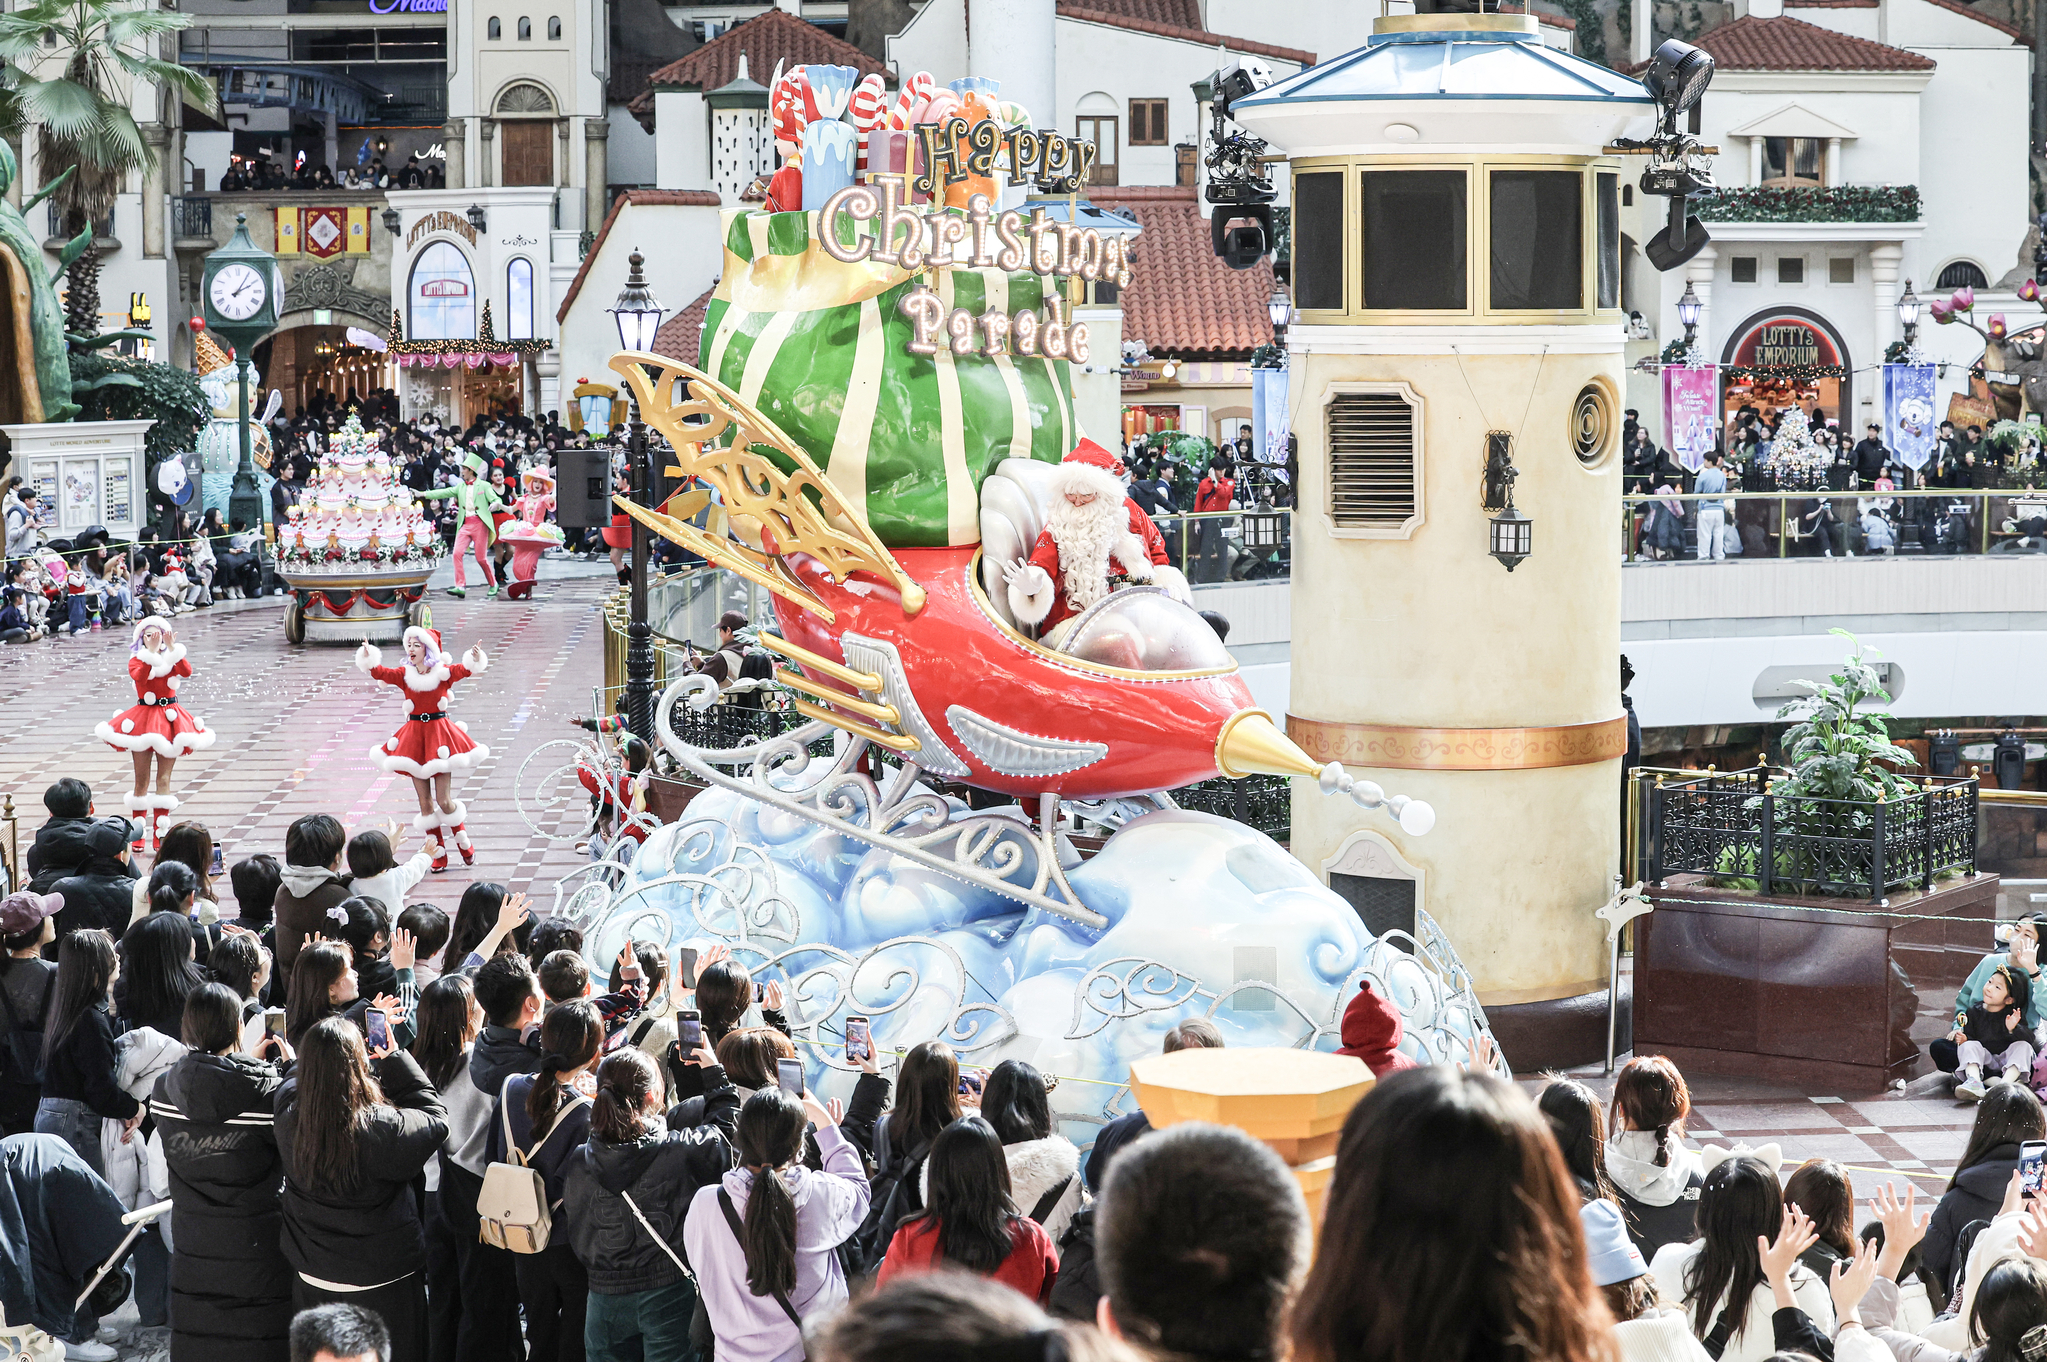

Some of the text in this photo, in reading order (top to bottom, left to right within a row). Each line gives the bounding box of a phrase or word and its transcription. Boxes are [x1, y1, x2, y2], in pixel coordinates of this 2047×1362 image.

[913, 117, 1097, 194] Happy
[817, 175, 1135, 288] Christmas
[898, 284, 1090, 364] Parade
[1755, 345, 1819, 366] EMPORIUM
